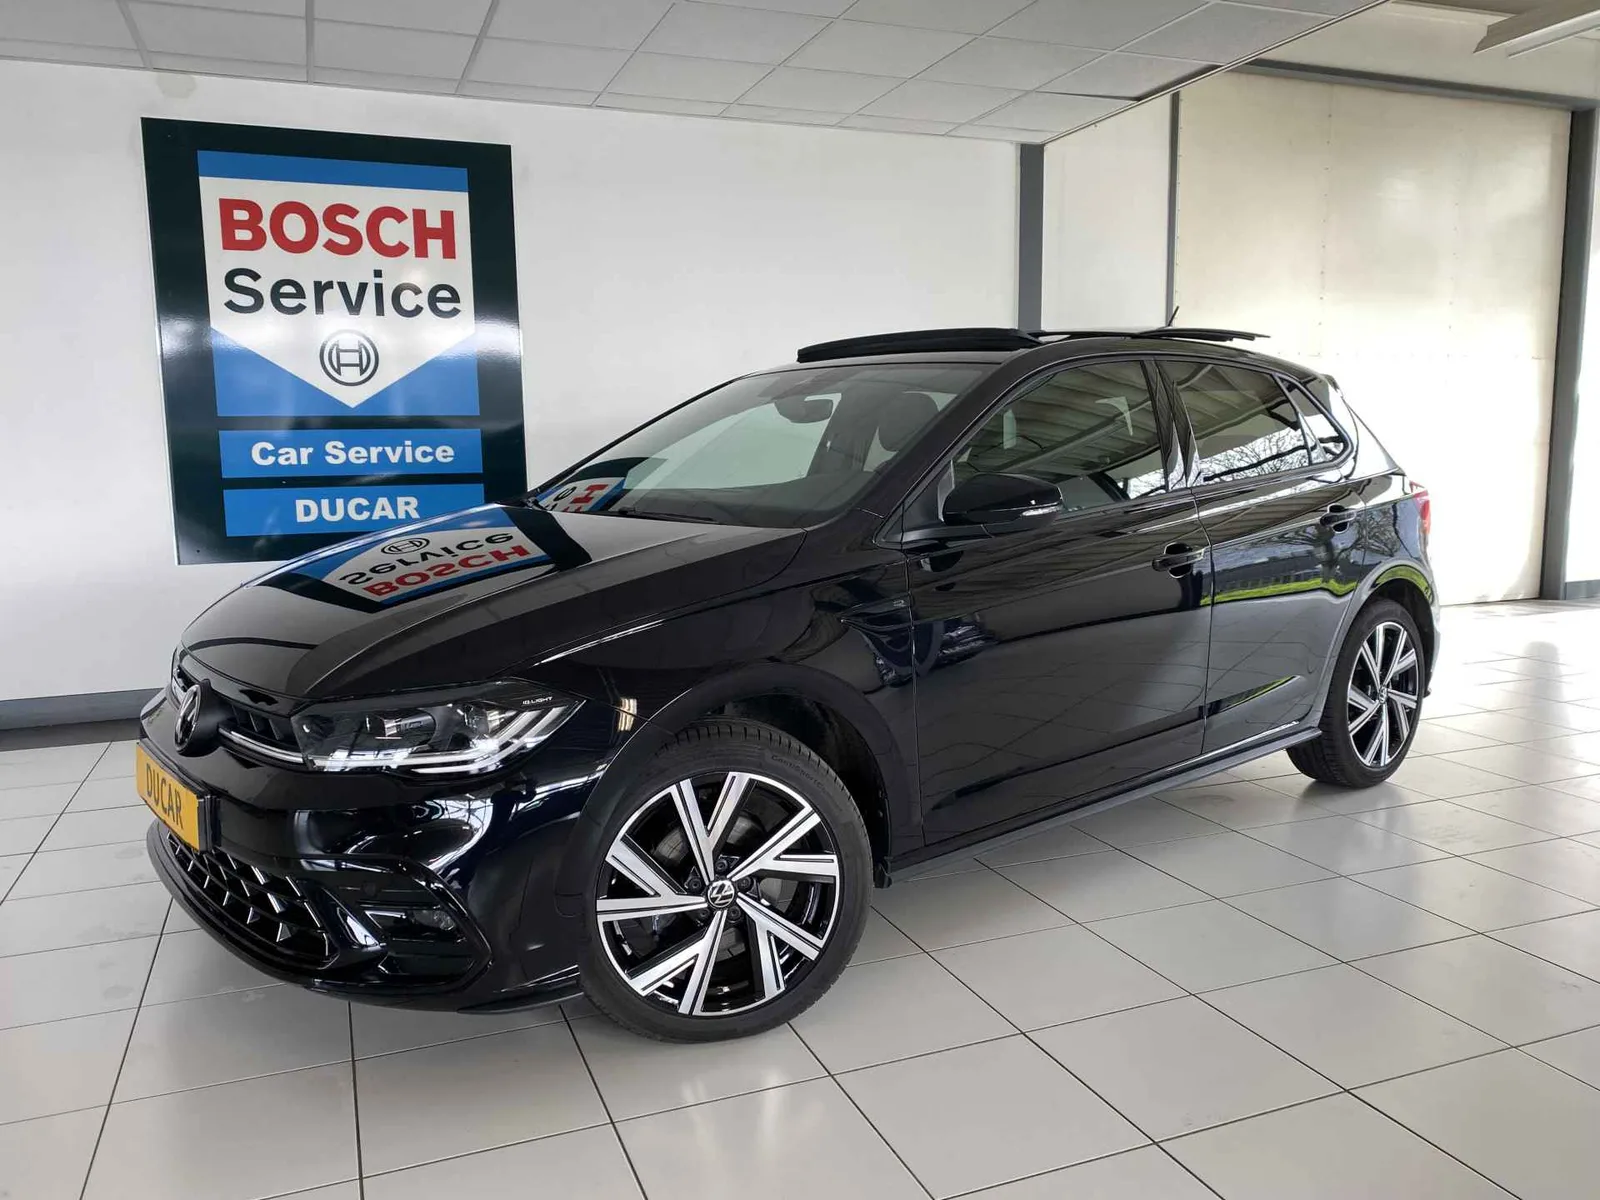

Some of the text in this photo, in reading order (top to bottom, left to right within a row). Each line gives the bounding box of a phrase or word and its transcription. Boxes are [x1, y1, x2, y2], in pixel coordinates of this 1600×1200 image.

[218, 197, 457, 260] BOSCH
[223, 267, 461, 318] Service
[251, 440, 455, 466] Car Service
[295, 496, 420, 523] DUCAR
[146, 763, 184, 829] DUCAR
